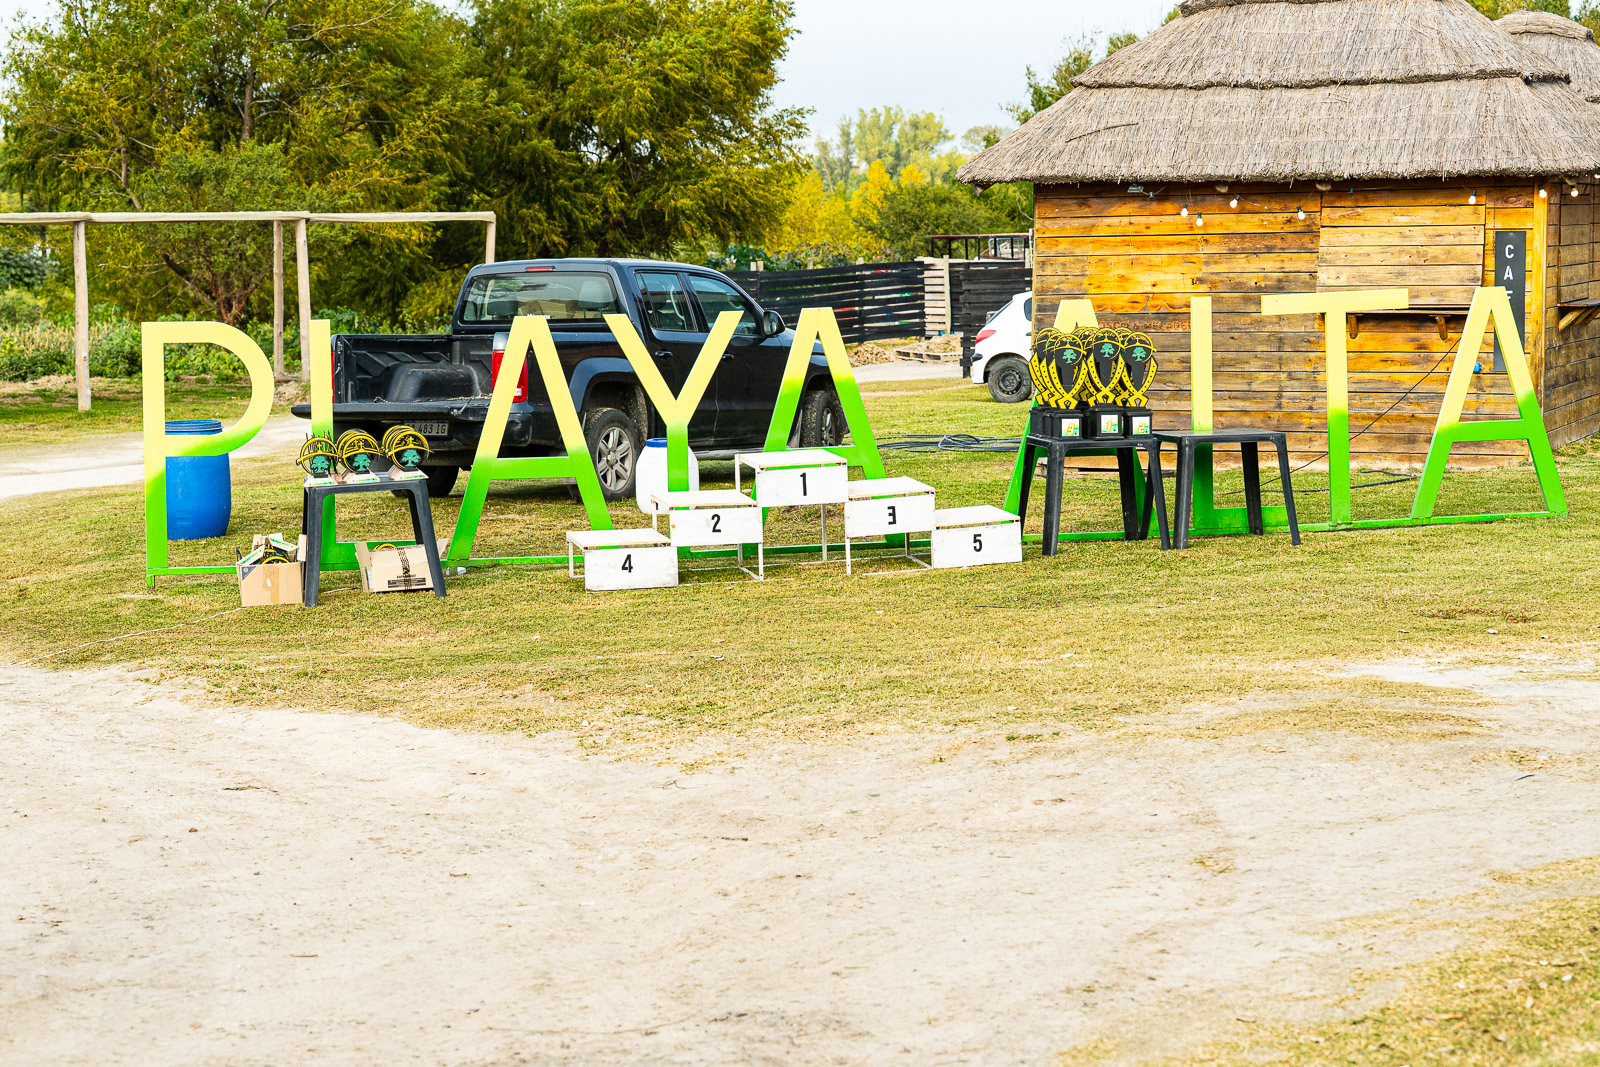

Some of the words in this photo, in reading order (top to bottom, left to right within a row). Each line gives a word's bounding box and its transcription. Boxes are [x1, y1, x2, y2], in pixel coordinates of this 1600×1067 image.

[1098, 321, 1130, 331] OSCO
[1144, 321, 1191, 331] HELADE
[418, 424, 433, 435] 483
[141, 307, 906, 587] PLAYA
[799, 472, 808, 497] 1
[711, 513, 722, 533] 2
[887, 505, 897, 525] 3
[973, 533, 983, 552] 5
[621, 554, 634, 573] 4
